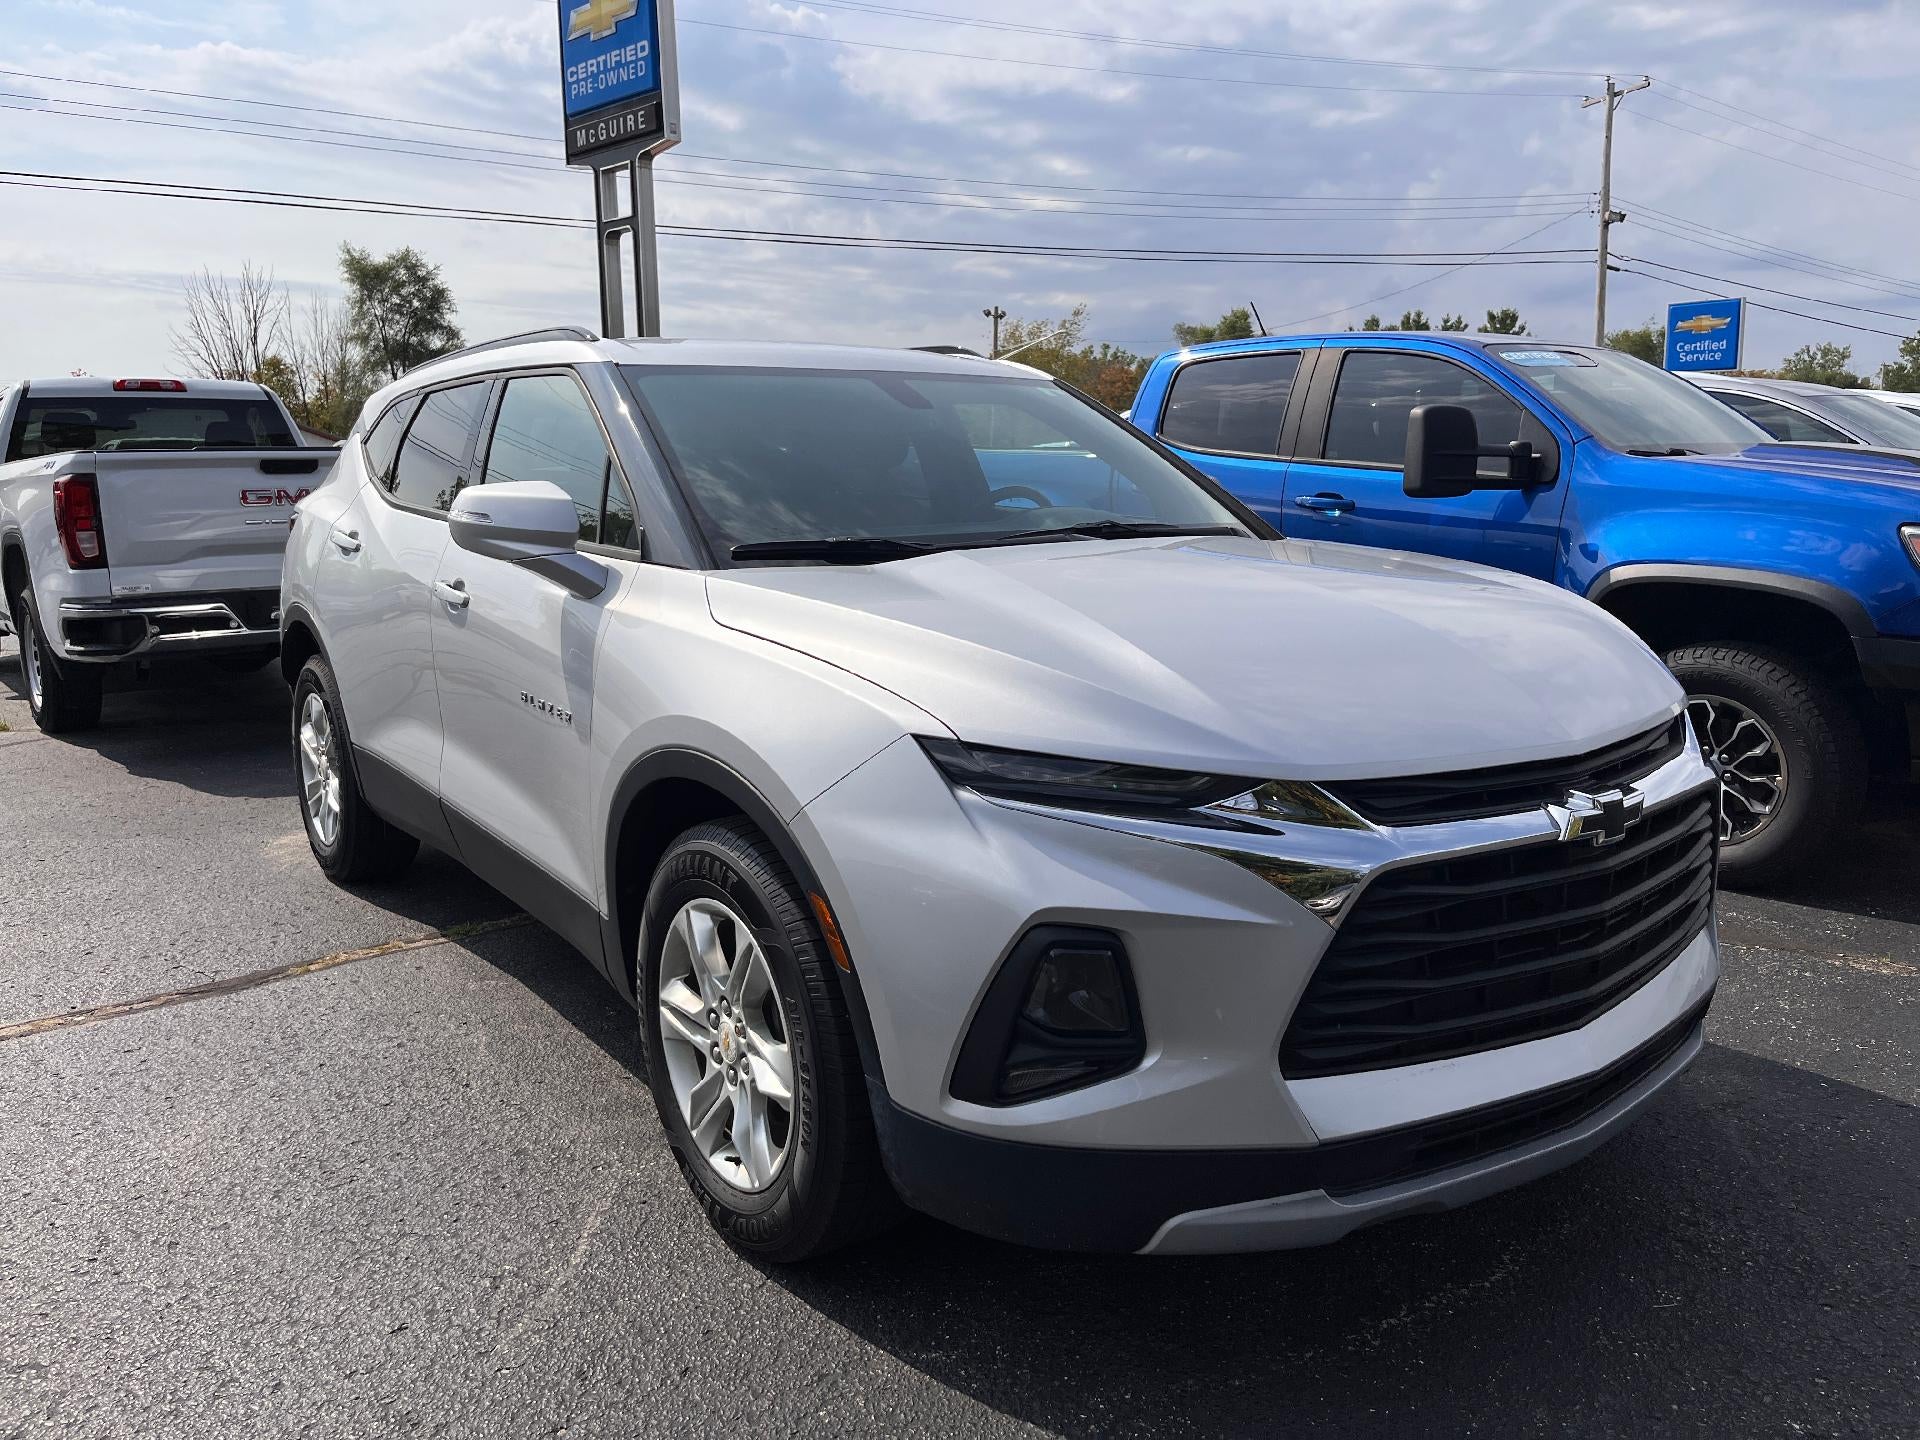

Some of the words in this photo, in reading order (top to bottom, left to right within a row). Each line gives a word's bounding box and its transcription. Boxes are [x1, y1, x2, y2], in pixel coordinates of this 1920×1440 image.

[567, 40, 649, 82] CERTIFIED
[571, 60, 646, 99] PRE-OWNED
[576, 110, 646, 148] McGUIRE
[1676, 339, 1727, 352] Certified
[1680, 351, 1722, 362] Service
[240, 487, 318, 507] GM
[520, 690, 572, 725] BLAZER
